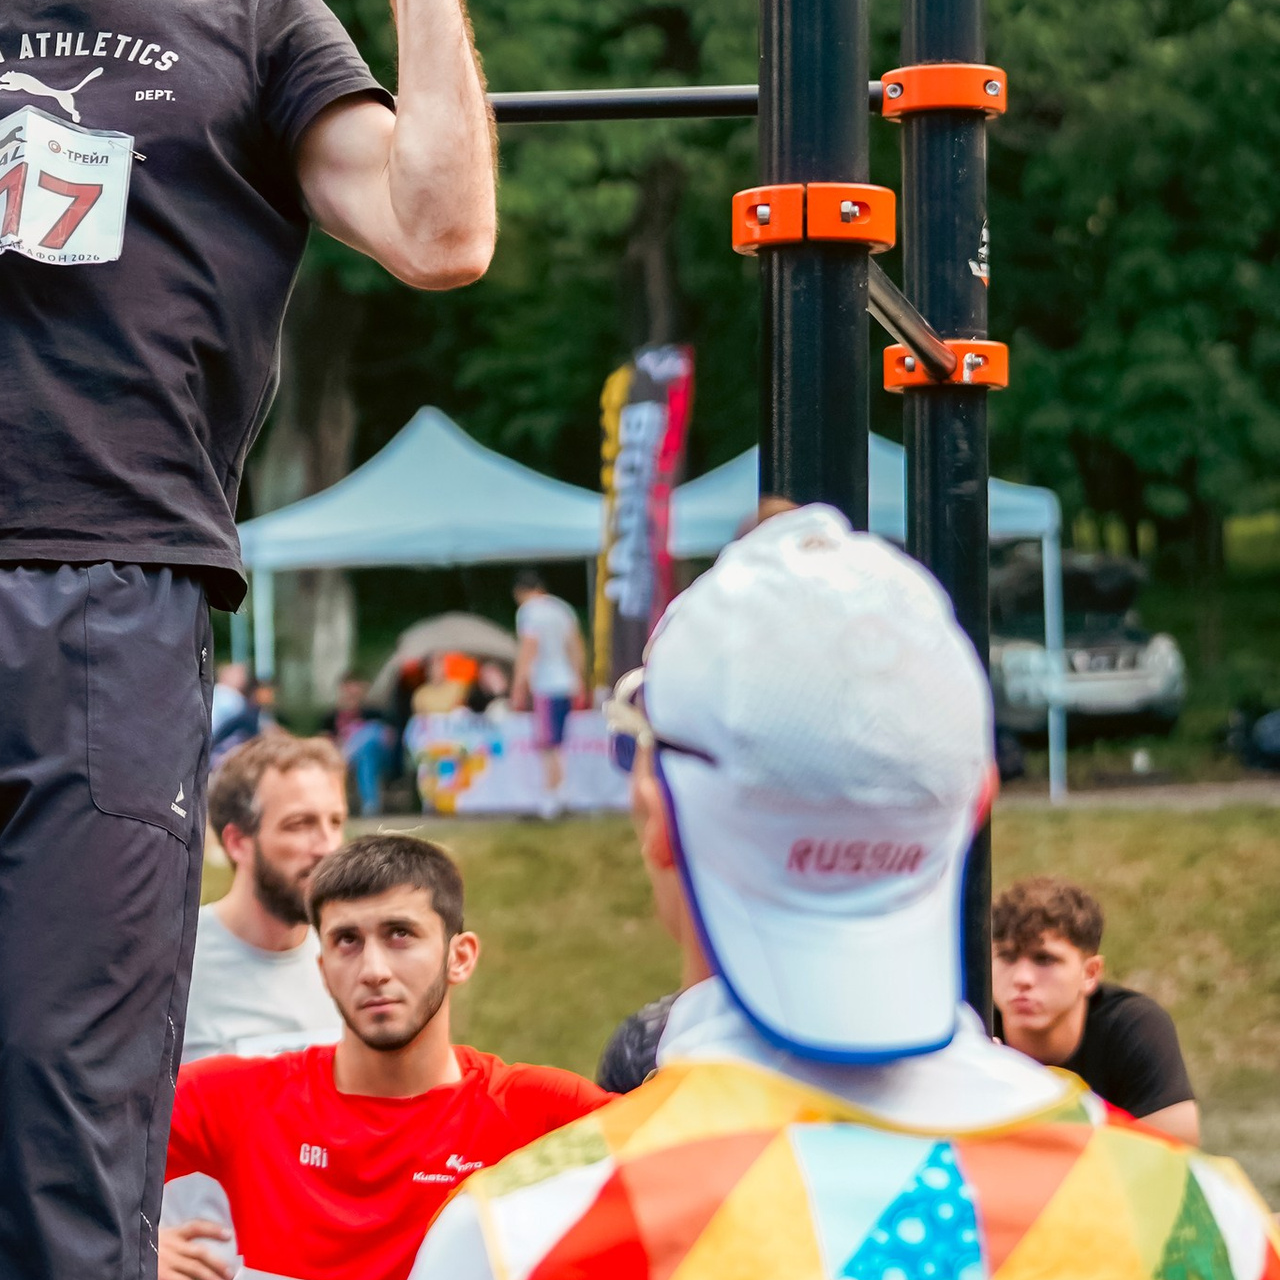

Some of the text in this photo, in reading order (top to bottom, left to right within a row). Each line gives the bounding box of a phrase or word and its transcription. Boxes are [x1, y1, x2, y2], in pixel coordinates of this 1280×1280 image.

[19, 32, 179, 71] ATHLETICS
[135, 90, 175, 101] DEPT.
[786, 838, 931, 875] RUSSIA
